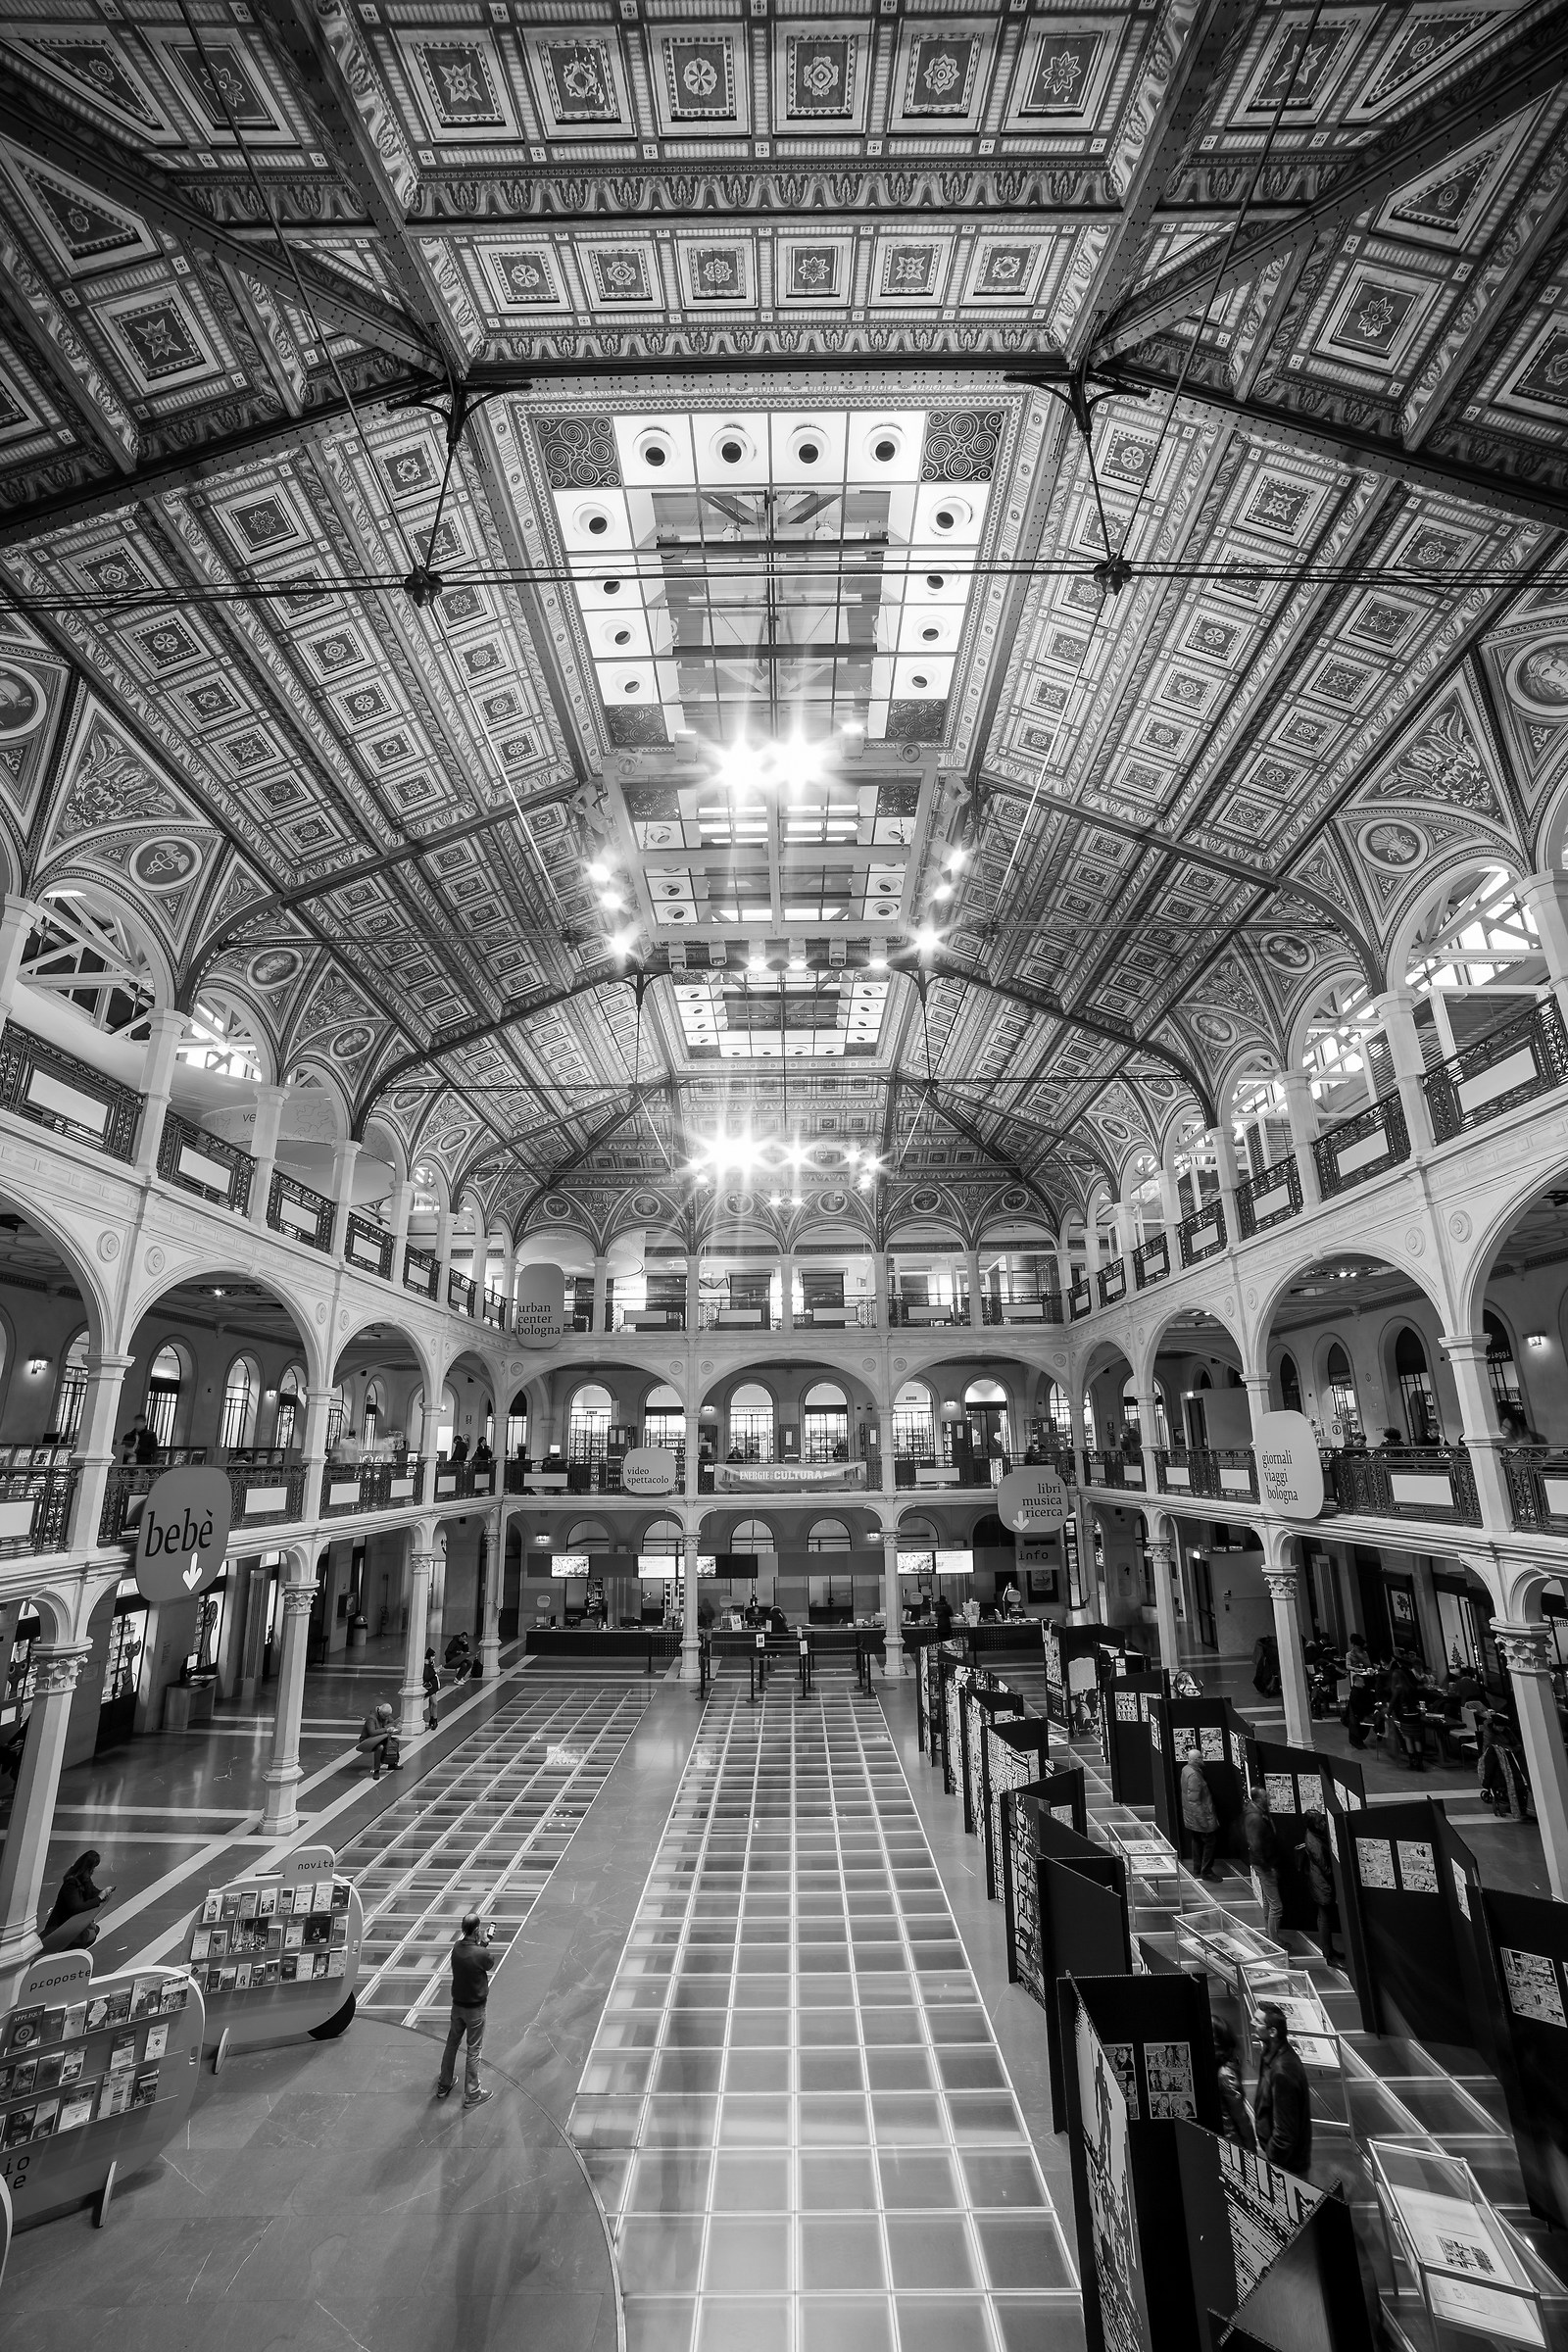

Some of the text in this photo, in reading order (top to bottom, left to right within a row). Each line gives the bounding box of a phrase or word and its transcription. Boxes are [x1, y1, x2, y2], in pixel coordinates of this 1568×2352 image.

[518, 1301, 551, 1313] urban
[517, 1315, 553, 1324] center
[517, 1324, 561, 1338] bologna
[1261, 1449, 1293, 1469] giornali
[627, 1466, 650, 1475] video
[739, 1470, 770, 1480] ENERGIE
[774, 1470, 822, 1480] CULTURA
[627, 1475, 669, 1487] spettacolo
[1264, 1468, 1289, 1487] viaggi
[1037, 1483, 1061, 1494] libri
[1022, 1494, 1062, 1506] musica
[1266, 1485, 1298, 1505] bologna
[1025, 1506, 1063, 1518] ricerca
[144, 1507, 214, 1557] bebè
[1019, 1550, 1049, 1560] info
[297, 1859, 334, 1870] novità
[29, 1969, 91, 1992] proposte
